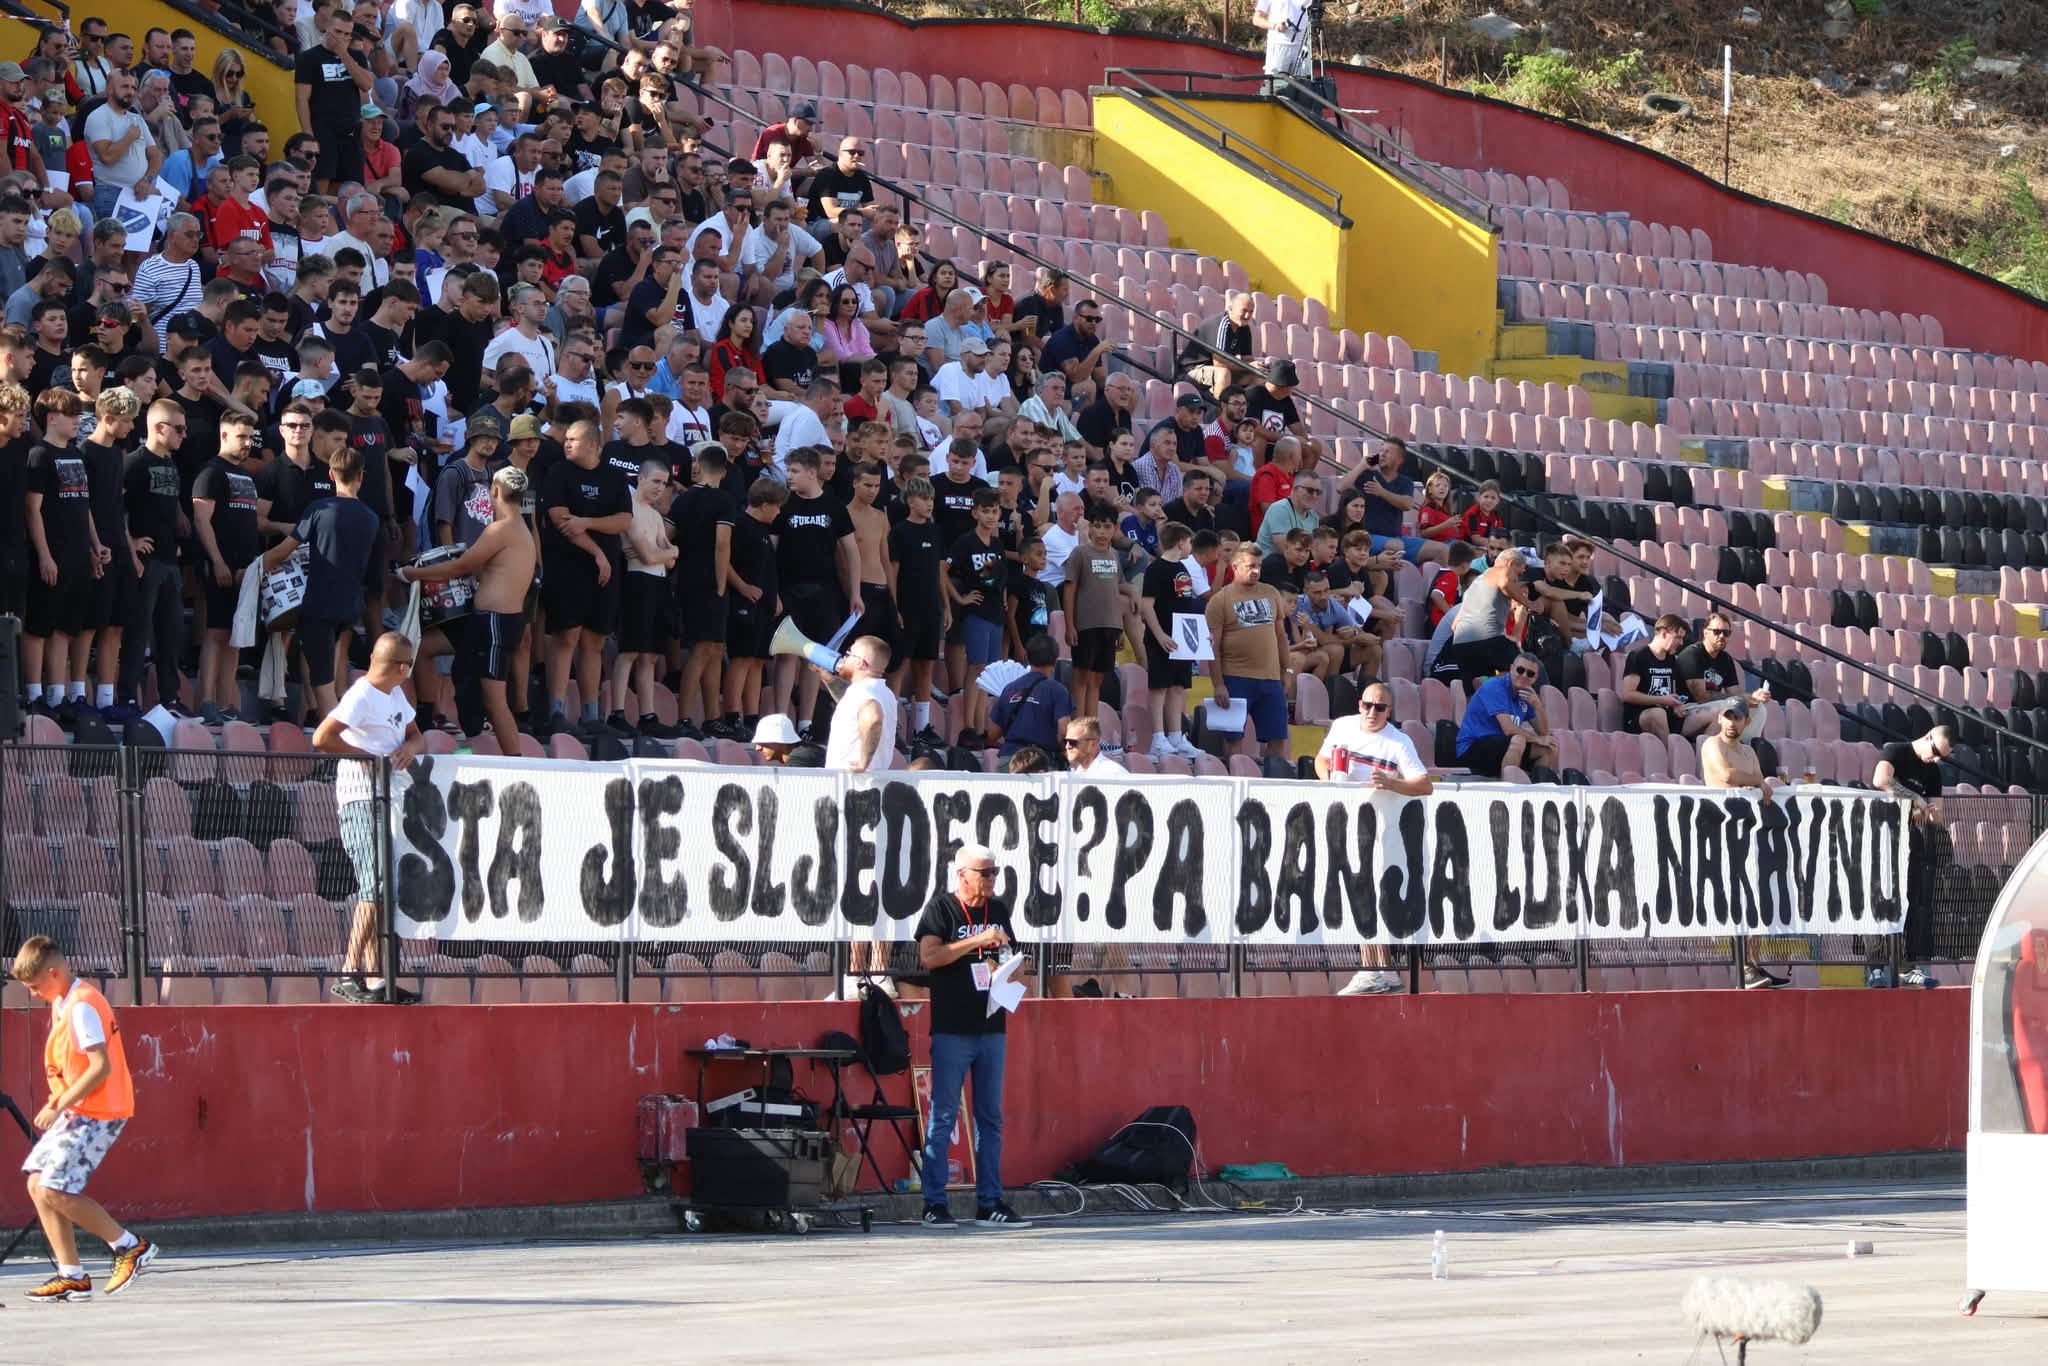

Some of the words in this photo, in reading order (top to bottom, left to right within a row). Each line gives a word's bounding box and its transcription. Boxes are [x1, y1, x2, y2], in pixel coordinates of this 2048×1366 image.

[609, 457, 640, 471] Reebo
[398, 755, 544, 923] ŠTA
[580, 775, 688, 928] JE
[1235, 798, 1475, 940] BANJA
